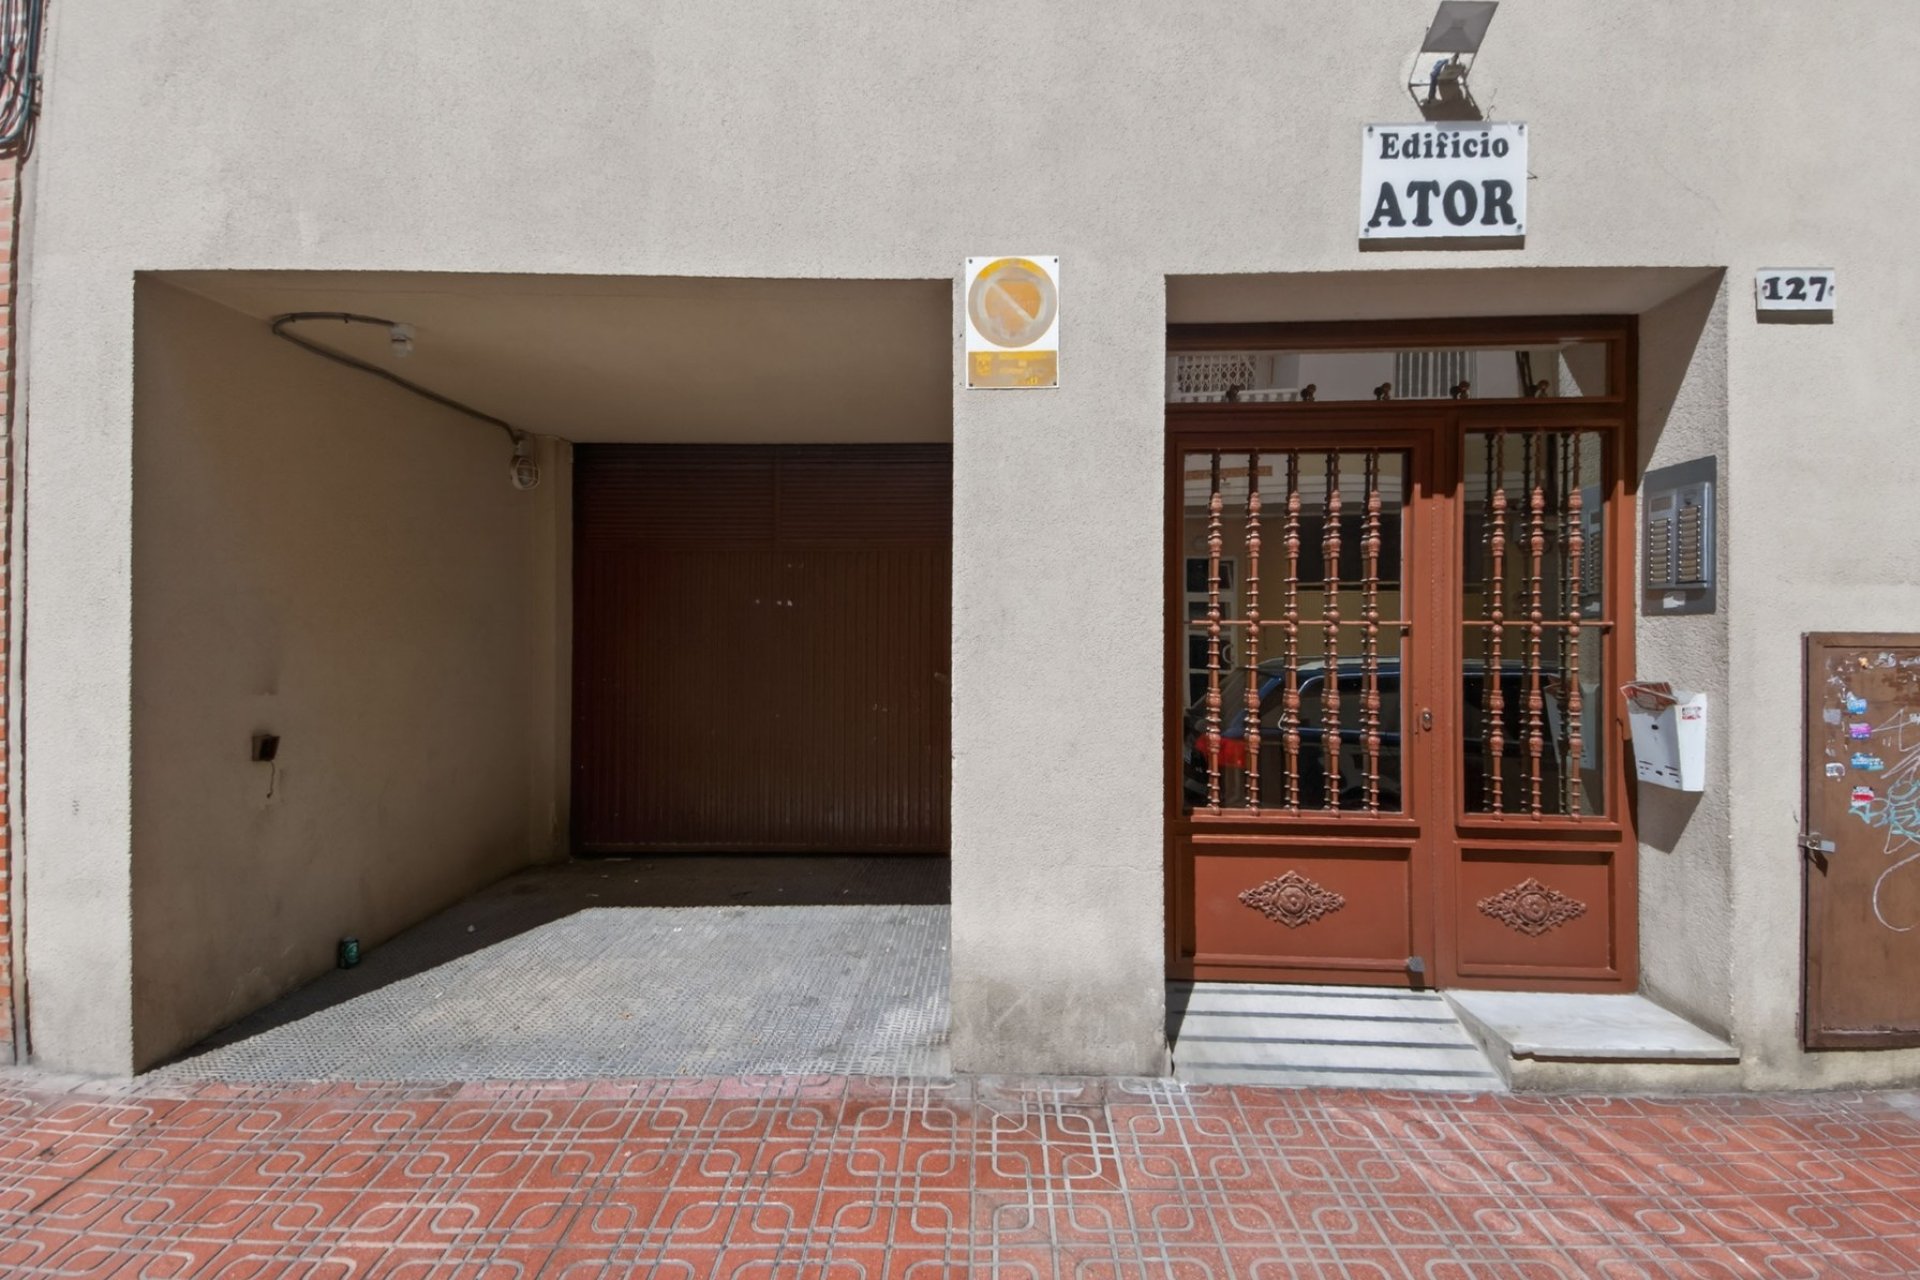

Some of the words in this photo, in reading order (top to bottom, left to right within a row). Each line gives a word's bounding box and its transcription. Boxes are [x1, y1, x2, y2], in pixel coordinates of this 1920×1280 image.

[1379, 131, 1510, 160] Edificio
[1366, 179, 1518, 228] ATOR
[1764, 276, 1828, 302] 127
